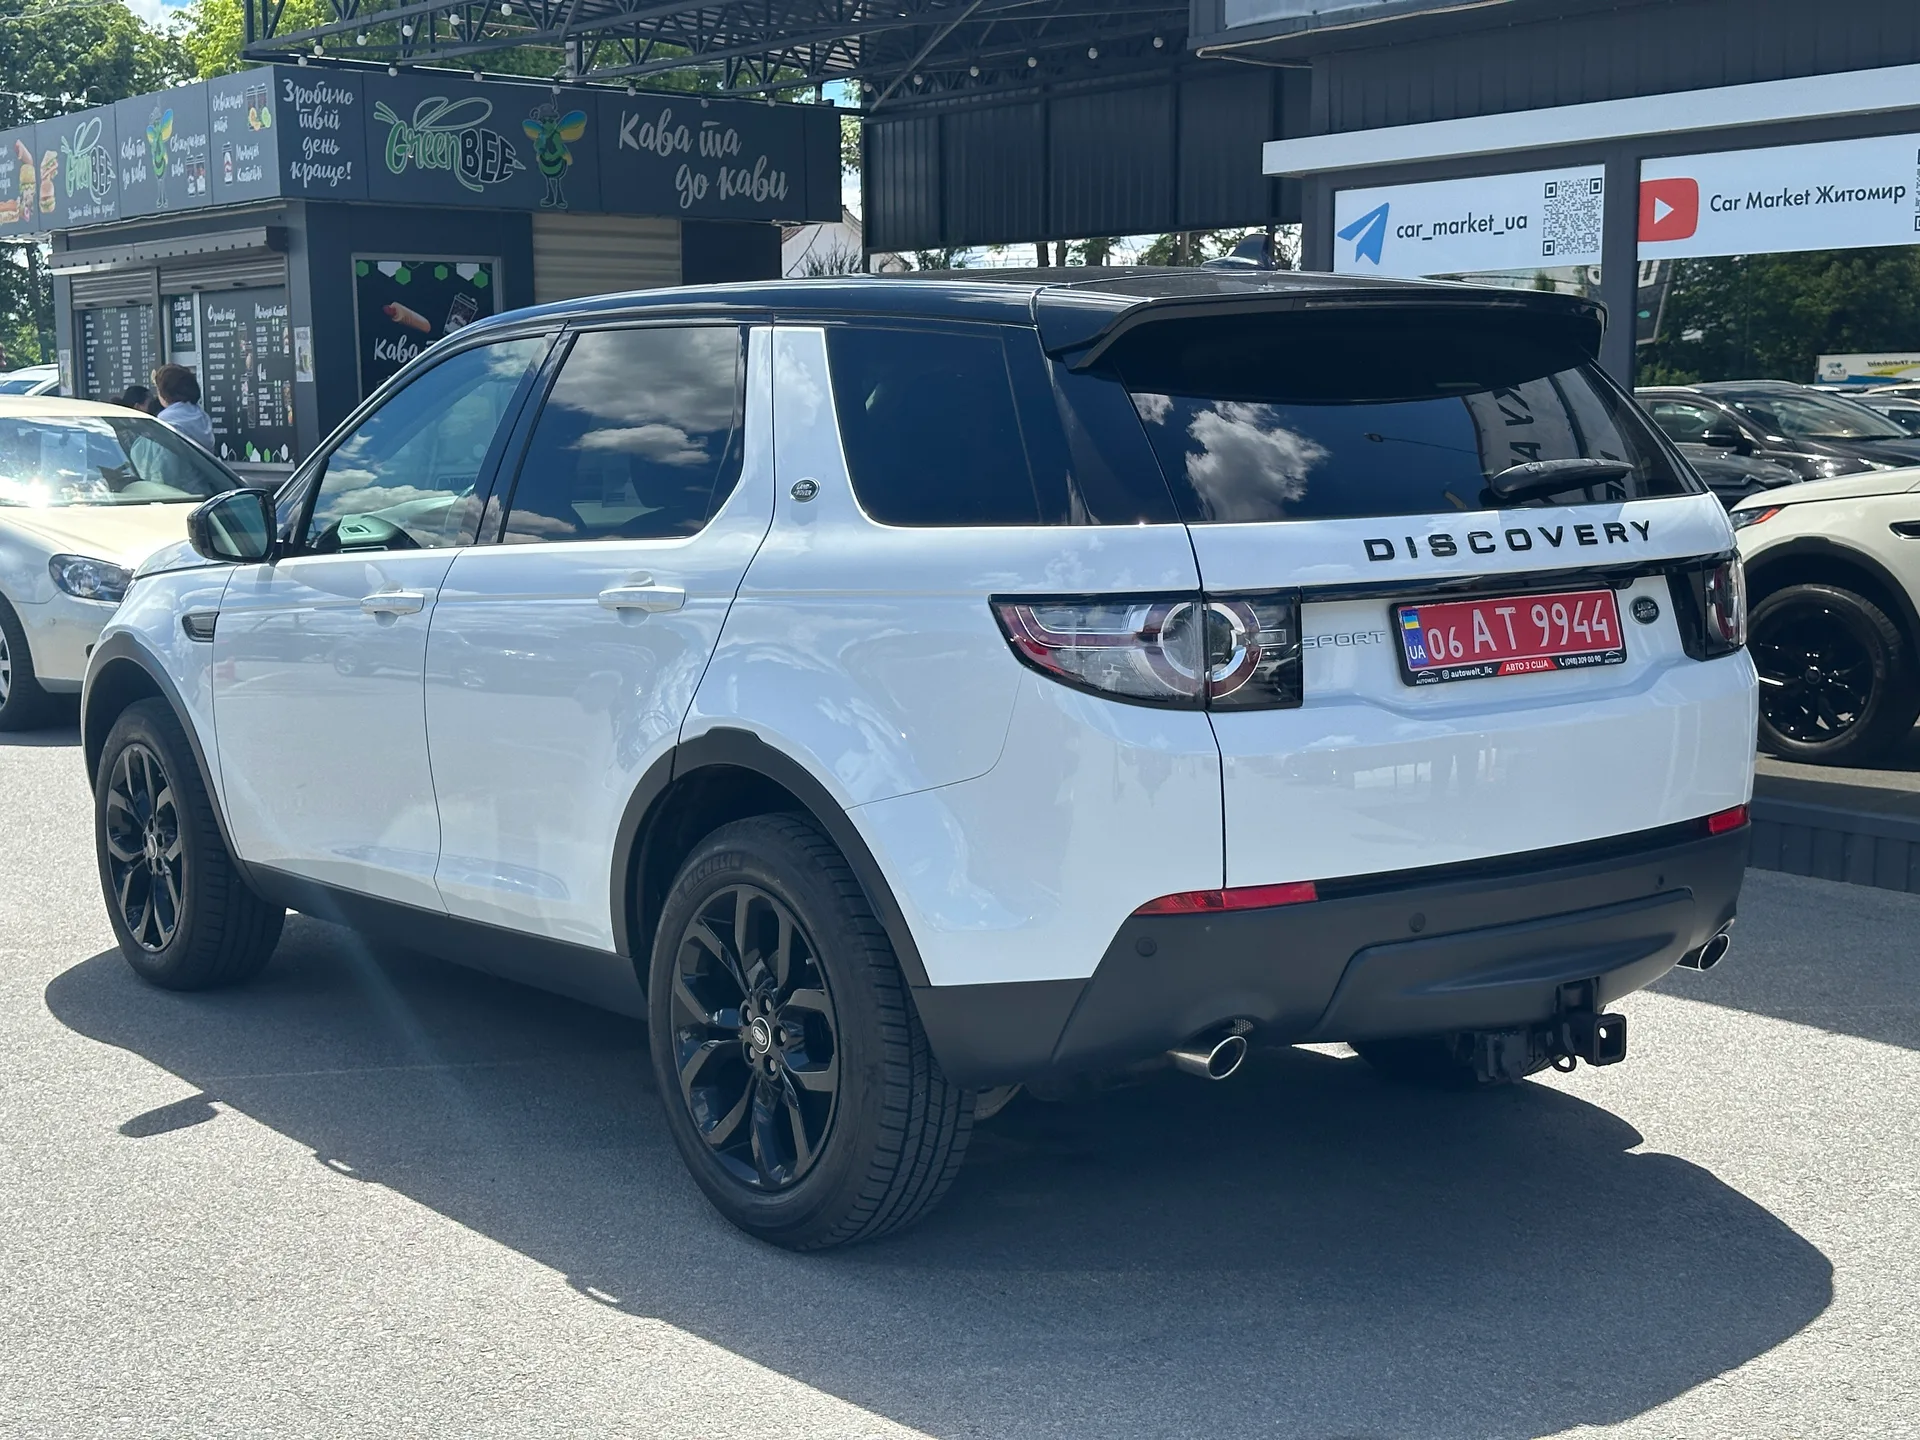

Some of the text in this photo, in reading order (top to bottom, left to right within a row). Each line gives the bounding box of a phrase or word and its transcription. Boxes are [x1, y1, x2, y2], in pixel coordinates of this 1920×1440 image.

[282, 78, 355, 111] Зробимо
[299, 105, 342, 131] твій
[618, 108, 742, 158] Кава та
[302, 135, 341, 160] день
[290, 161, 353, 188] краще!
[675, 155, 789, 209] до кави
[1709, 185, 1906, 213] Car Market Житомир
[1396, 212, 1528, 241] car_market_ua
[374, 334, 419, 363] Кава
[1363, 520, 1651, 563] DISCOVERY
[1302, 631, 1387, 650] SPORT
[1427, 600, 1611, 661] 06 AT 9944
[1409, 645, 1427, 660] UA
[1505, 661, 1525, 673] АВТО
[1531, 658, 1549, 671] США
[1416, 676, 1439, 685] AUTOWELT
